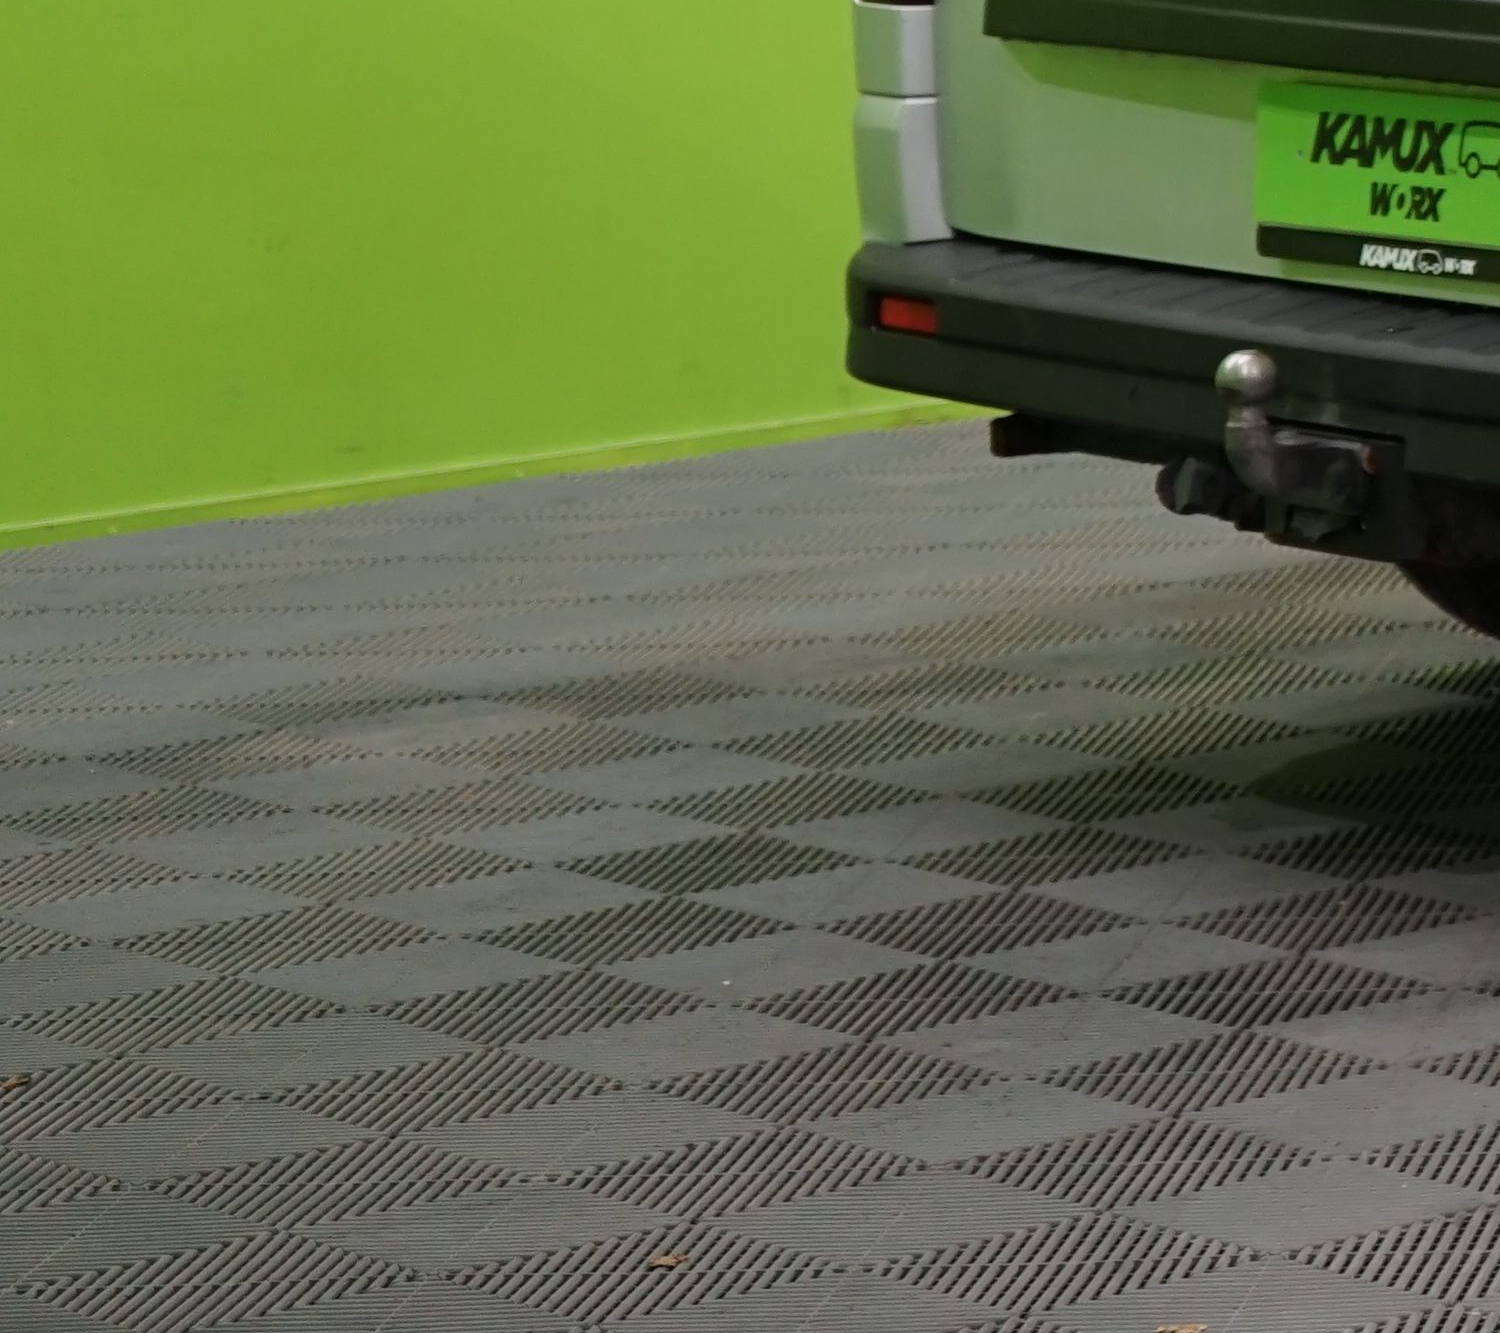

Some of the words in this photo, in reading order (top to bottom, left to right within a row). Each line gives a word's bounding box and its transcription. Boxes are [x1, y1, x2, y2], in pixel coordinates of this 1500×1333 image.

[1310, 111, 1455, 175] KAMUX
[1370, 181, 1446, 222] WORX
[1359, 243, 1418, 273] KAMUX
